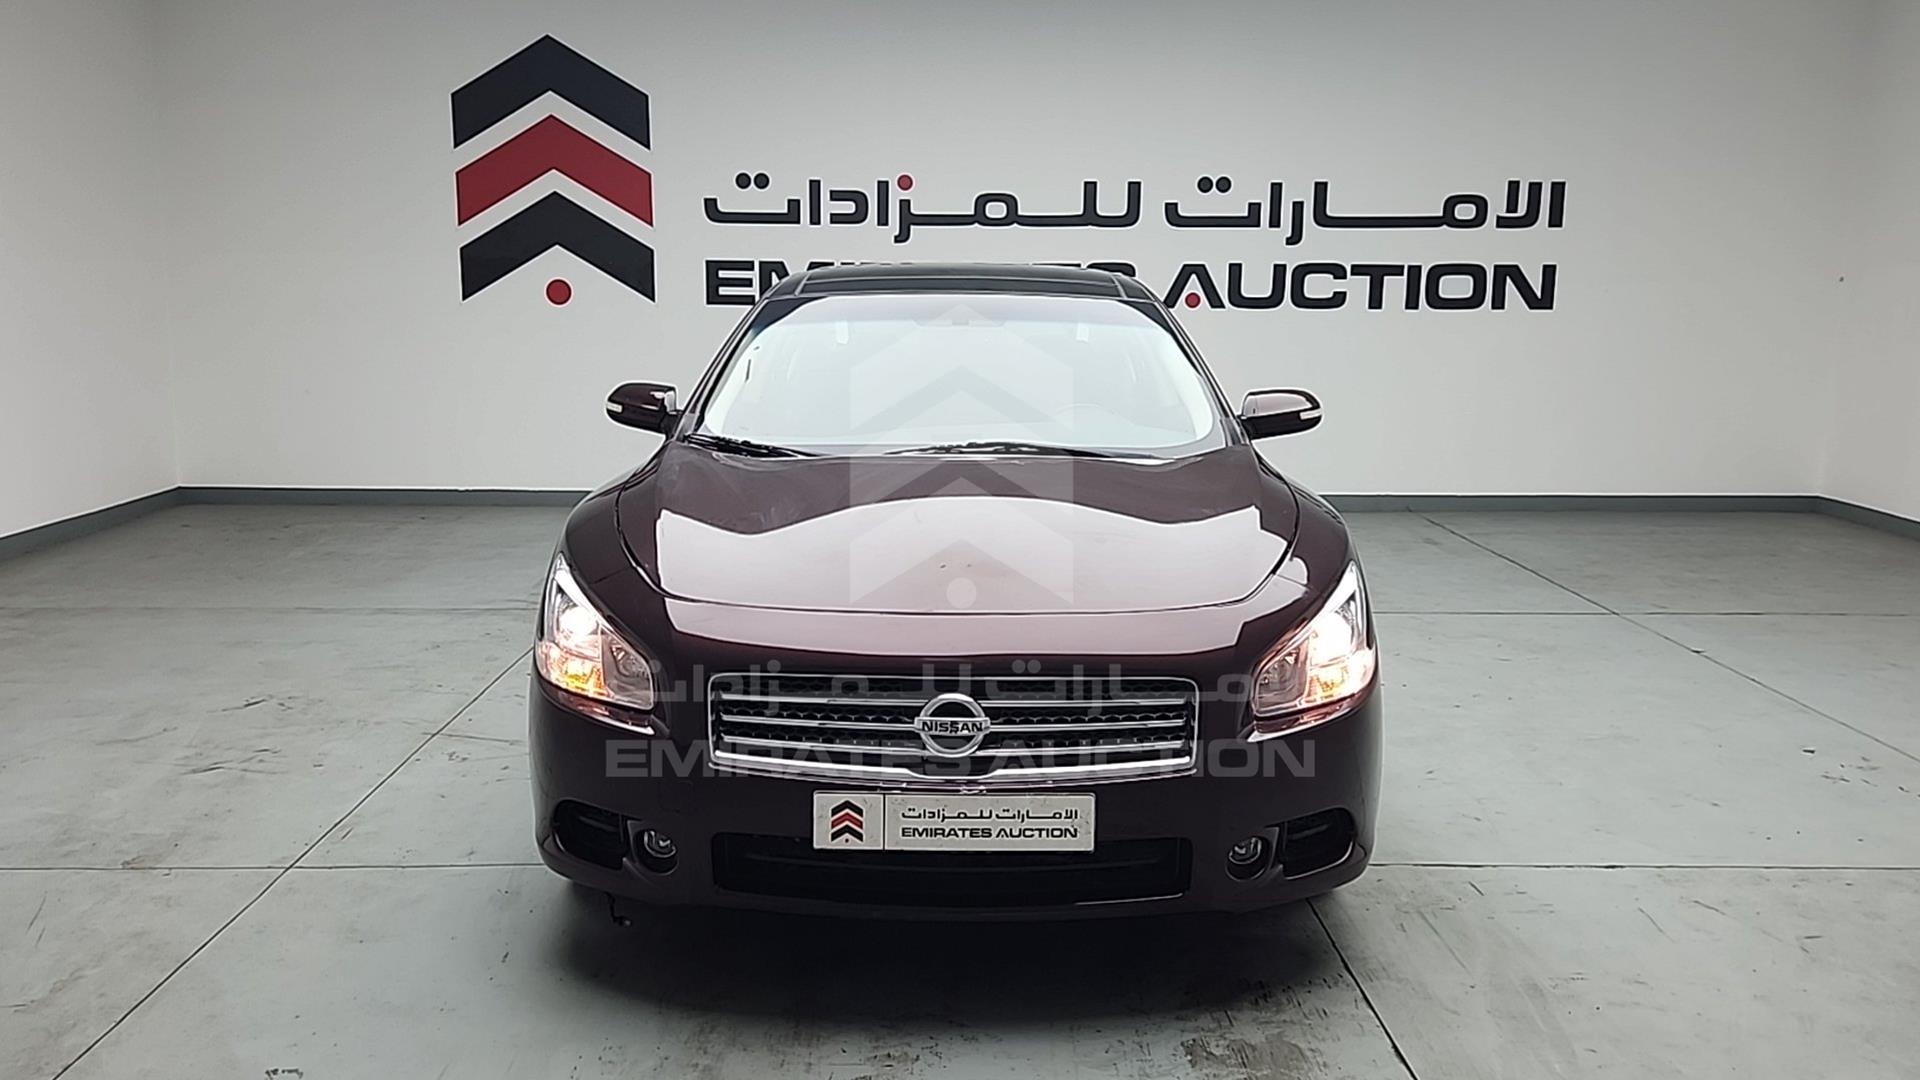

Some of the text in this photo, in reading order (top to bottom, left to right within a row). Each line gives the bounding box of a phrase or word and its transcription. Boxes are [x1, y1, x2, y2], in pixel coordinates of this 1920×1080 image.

[703, 171, 1566, 246] الامارات للمزادات
[1164, 263, 1557, 310] AUCTION
[921, 721, 983, 733] NISSAN
[902, 807, 1078, 823] الامارات للمزادات
[901, 827, 1078, 839] EMIRATES AUCTION
